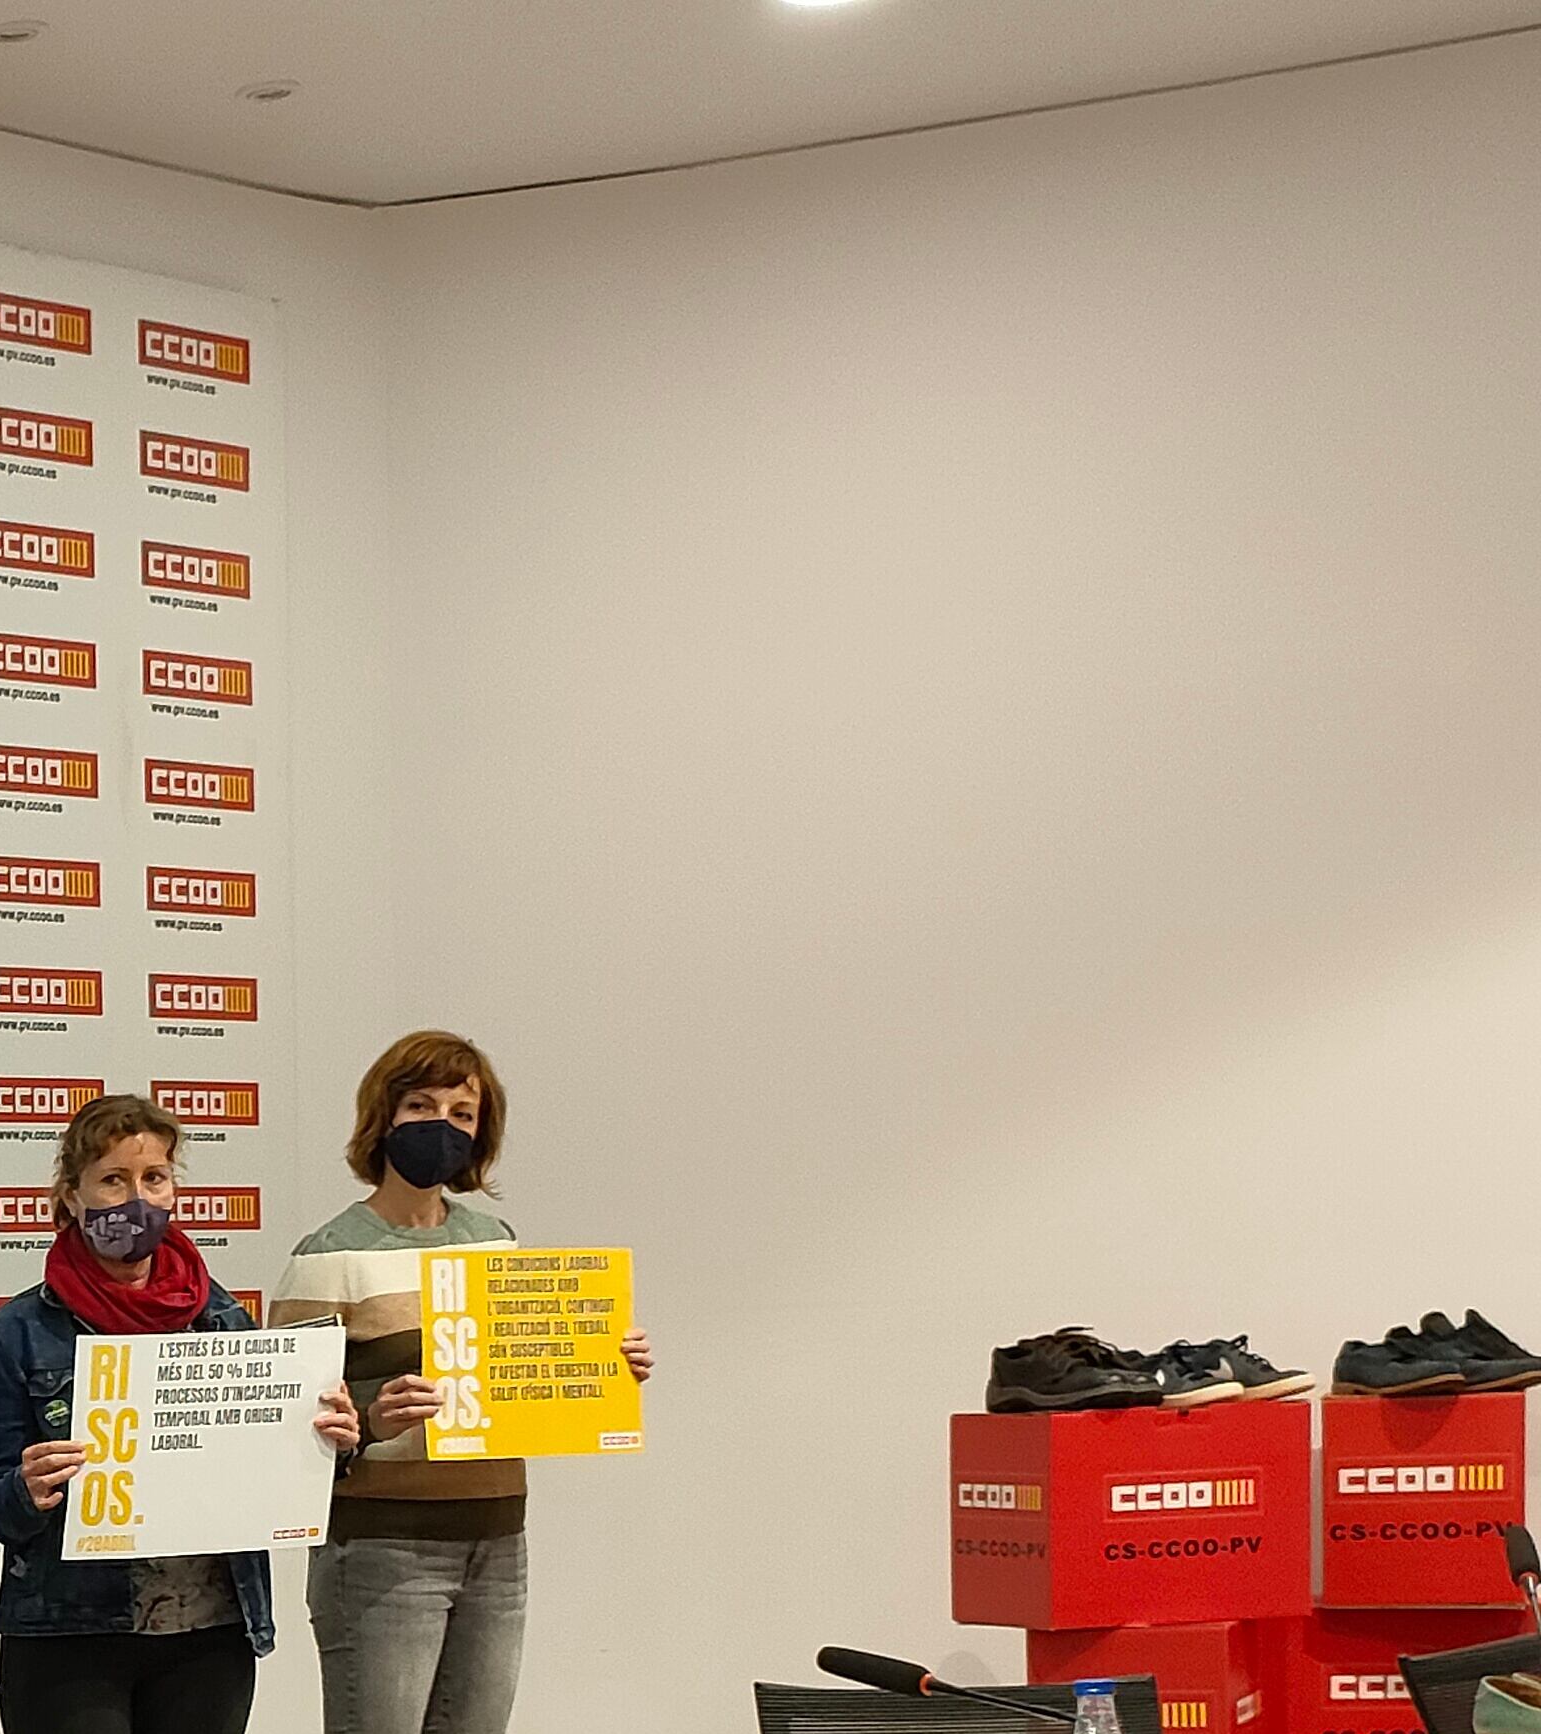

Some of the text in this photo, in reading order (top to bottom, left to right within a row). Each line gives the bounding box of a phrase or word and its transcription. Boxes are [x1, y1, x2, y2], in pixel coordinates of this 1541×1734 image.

[431, 1258, 466, 1313] RI
[212, 1338, 224, 1356] ÉS
[228, 1340, 240, 1355] LA
[245, 1338, 279, 1354] CAUSA
[283, 1338, 296, 1353] DE
[432, 1317, 478, 1371] SC
[90, 1344, 132, 1401] RI
[157, 1361, 271, 1381] MÉS DEL 50 % DELS
[155, 1387, 219, 1404] PROCESSOS
[434, 1375, 491, 1430] OS.
[154, 1410, 211, 1427] TEMPORAL
[216, 1409, 241, 1425] AMB
[86, 1408, 139, 1464] SC
[1338, 1465, 1455, 1493] CCOO
[81, 1470, 144, 1526] OS.
[959, 1482, 1015, 1510] CCOO
[1111, 1480, 1214, 1512] CCOO
[1104, 1536, 1263, 1561] CS-CCOO-PV
[1330, 1675, 1412, 1700] CCO
